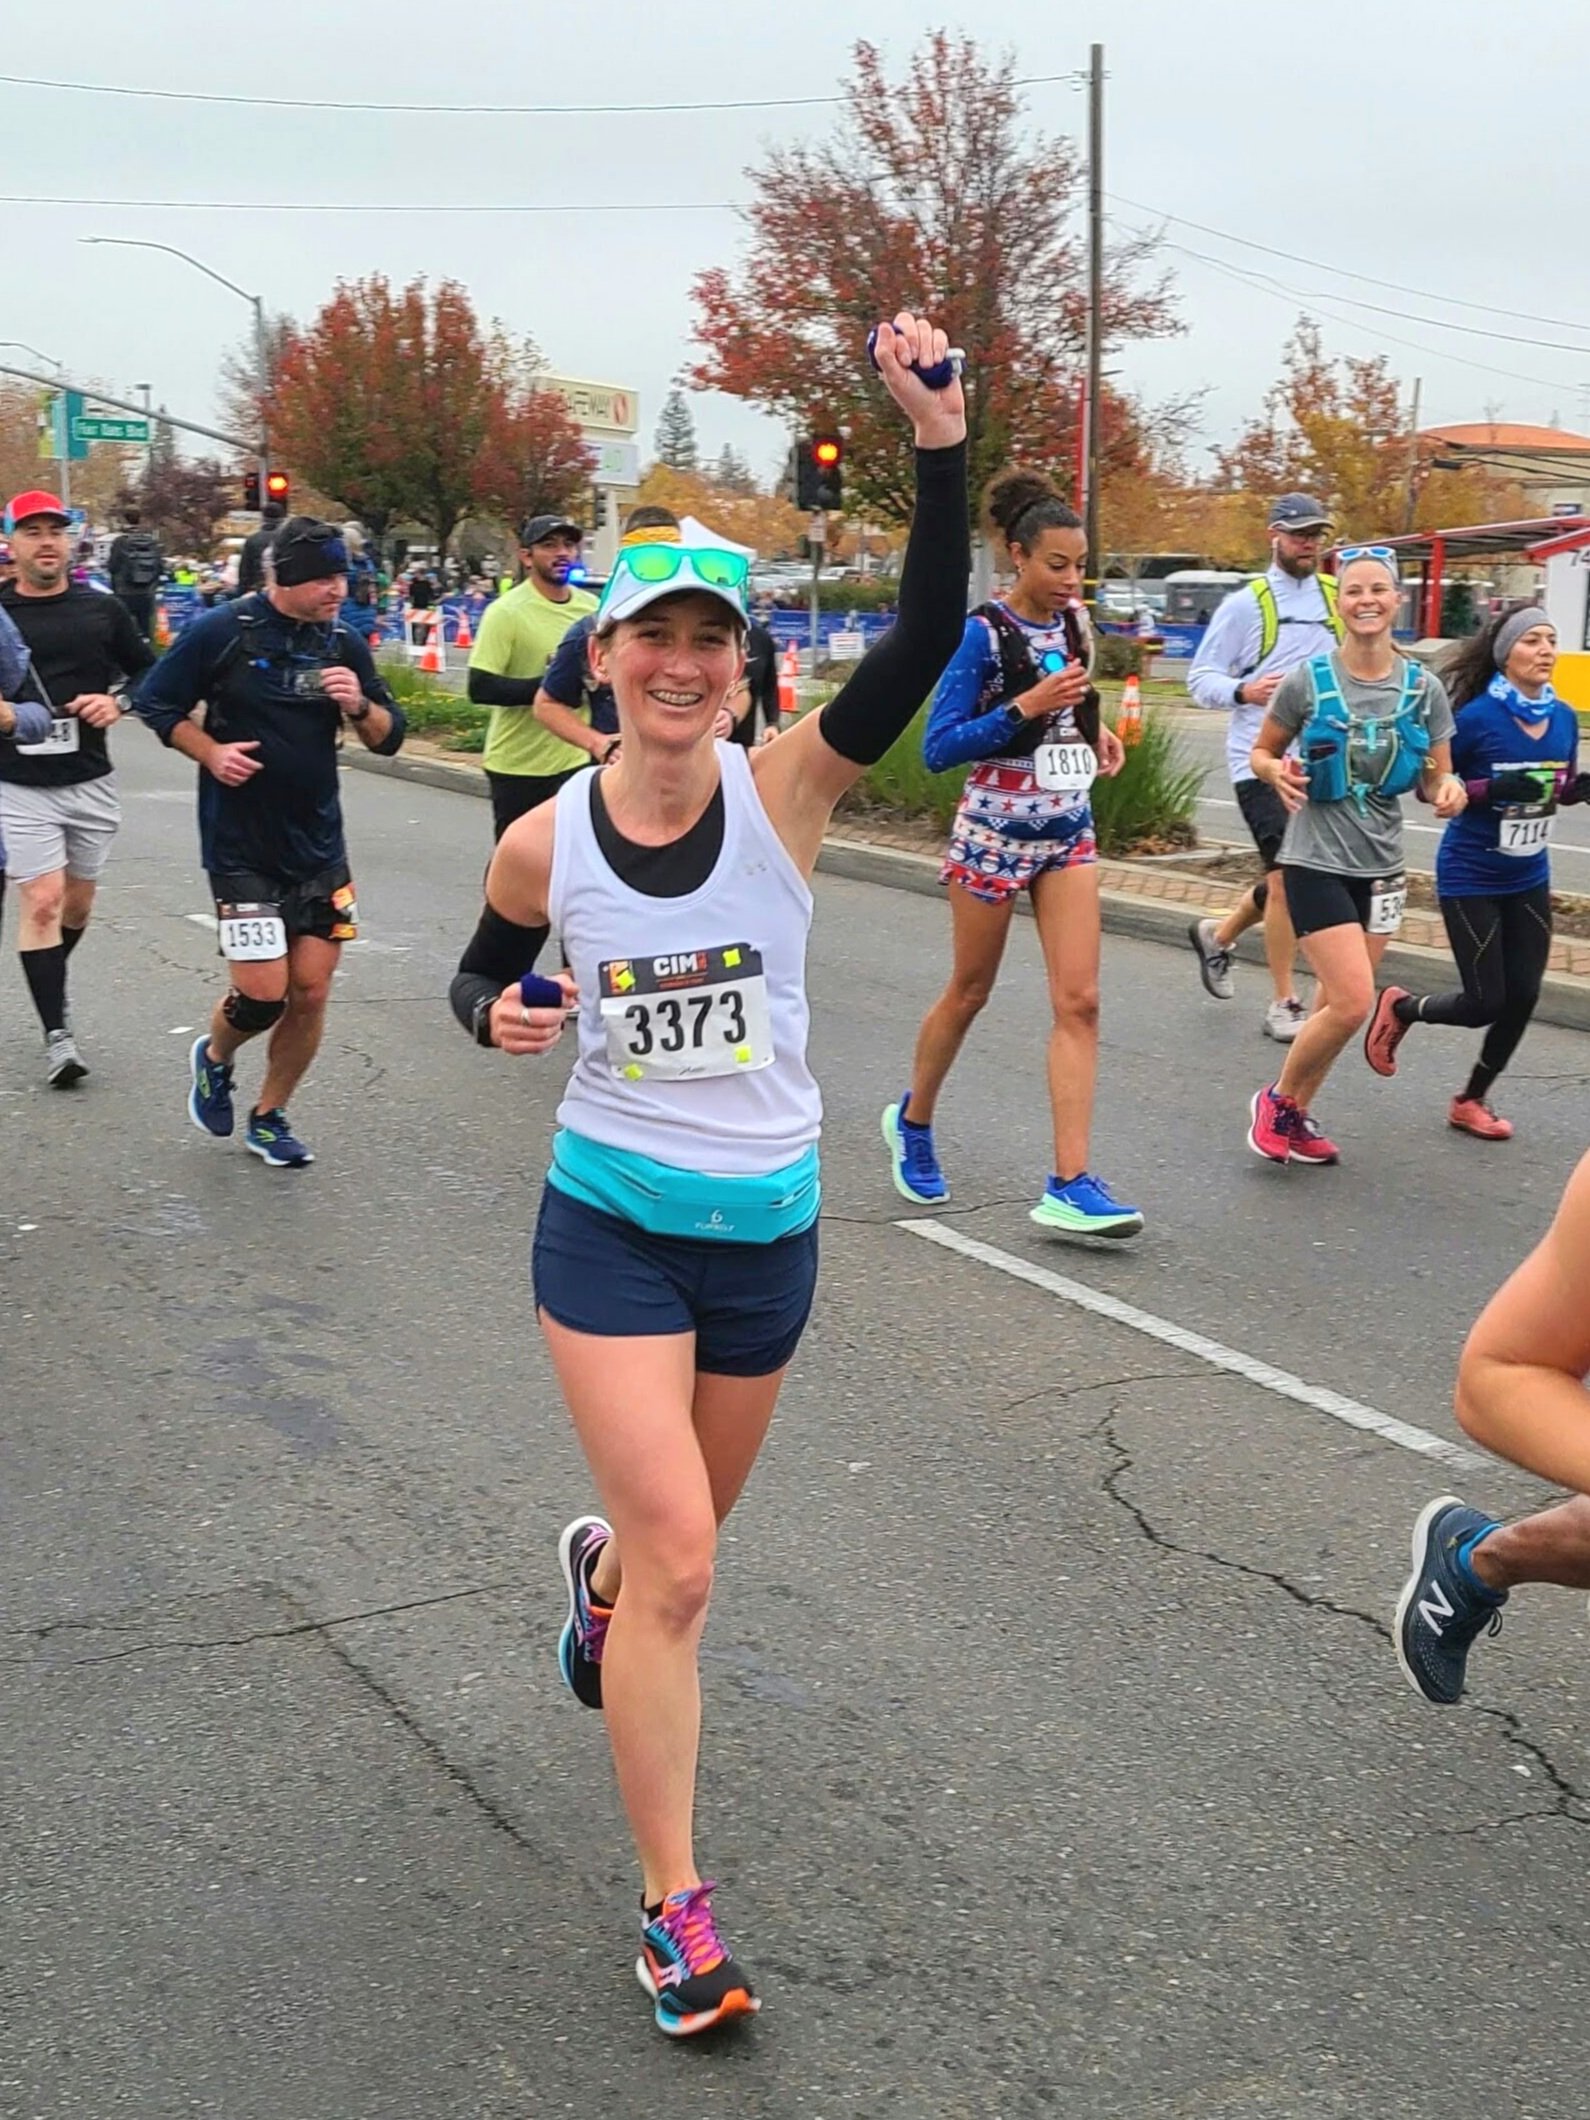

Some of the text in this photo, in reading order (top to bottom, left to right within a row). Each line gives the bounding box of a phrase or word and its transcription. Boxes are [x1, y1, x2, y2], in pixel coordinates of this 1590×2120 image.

[1048, 748, 1092, 775] 1810
[228, 922, 277, 948] 1533
[653, 952, 698, 977] CIM
[625, 990, 747, 1056] 3373
